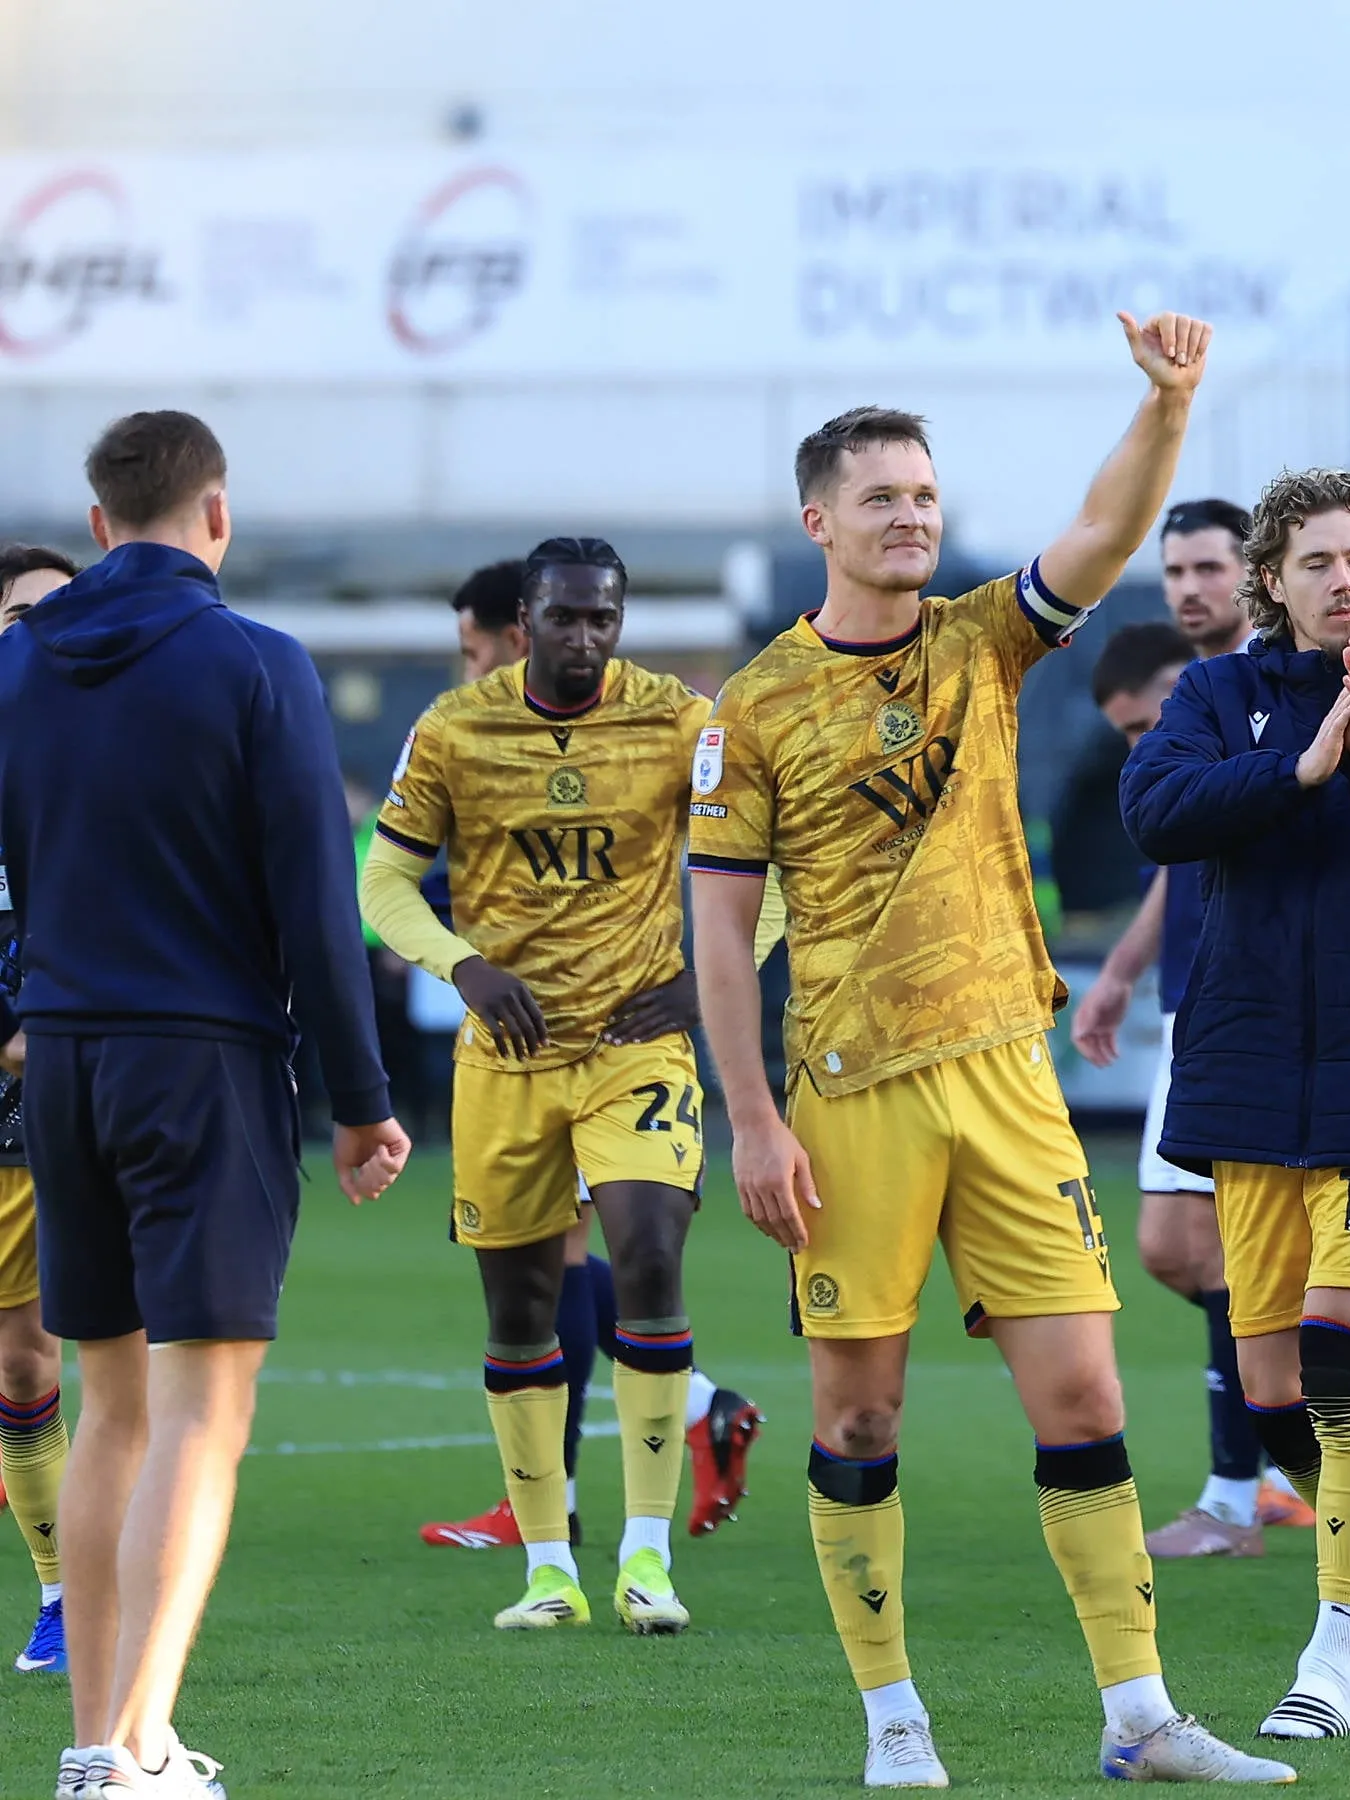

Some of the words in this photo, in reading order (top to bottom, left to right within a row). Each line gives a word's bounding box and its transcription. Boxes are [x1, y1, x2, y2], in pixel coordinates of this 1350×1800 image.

[797, 168, 1190, 246] IMPERIAL
[797, 256, 1288, 340] DUCTWORK
[509, 826, 622, 883] WR
[632, 1081, 701, 1144] 24
